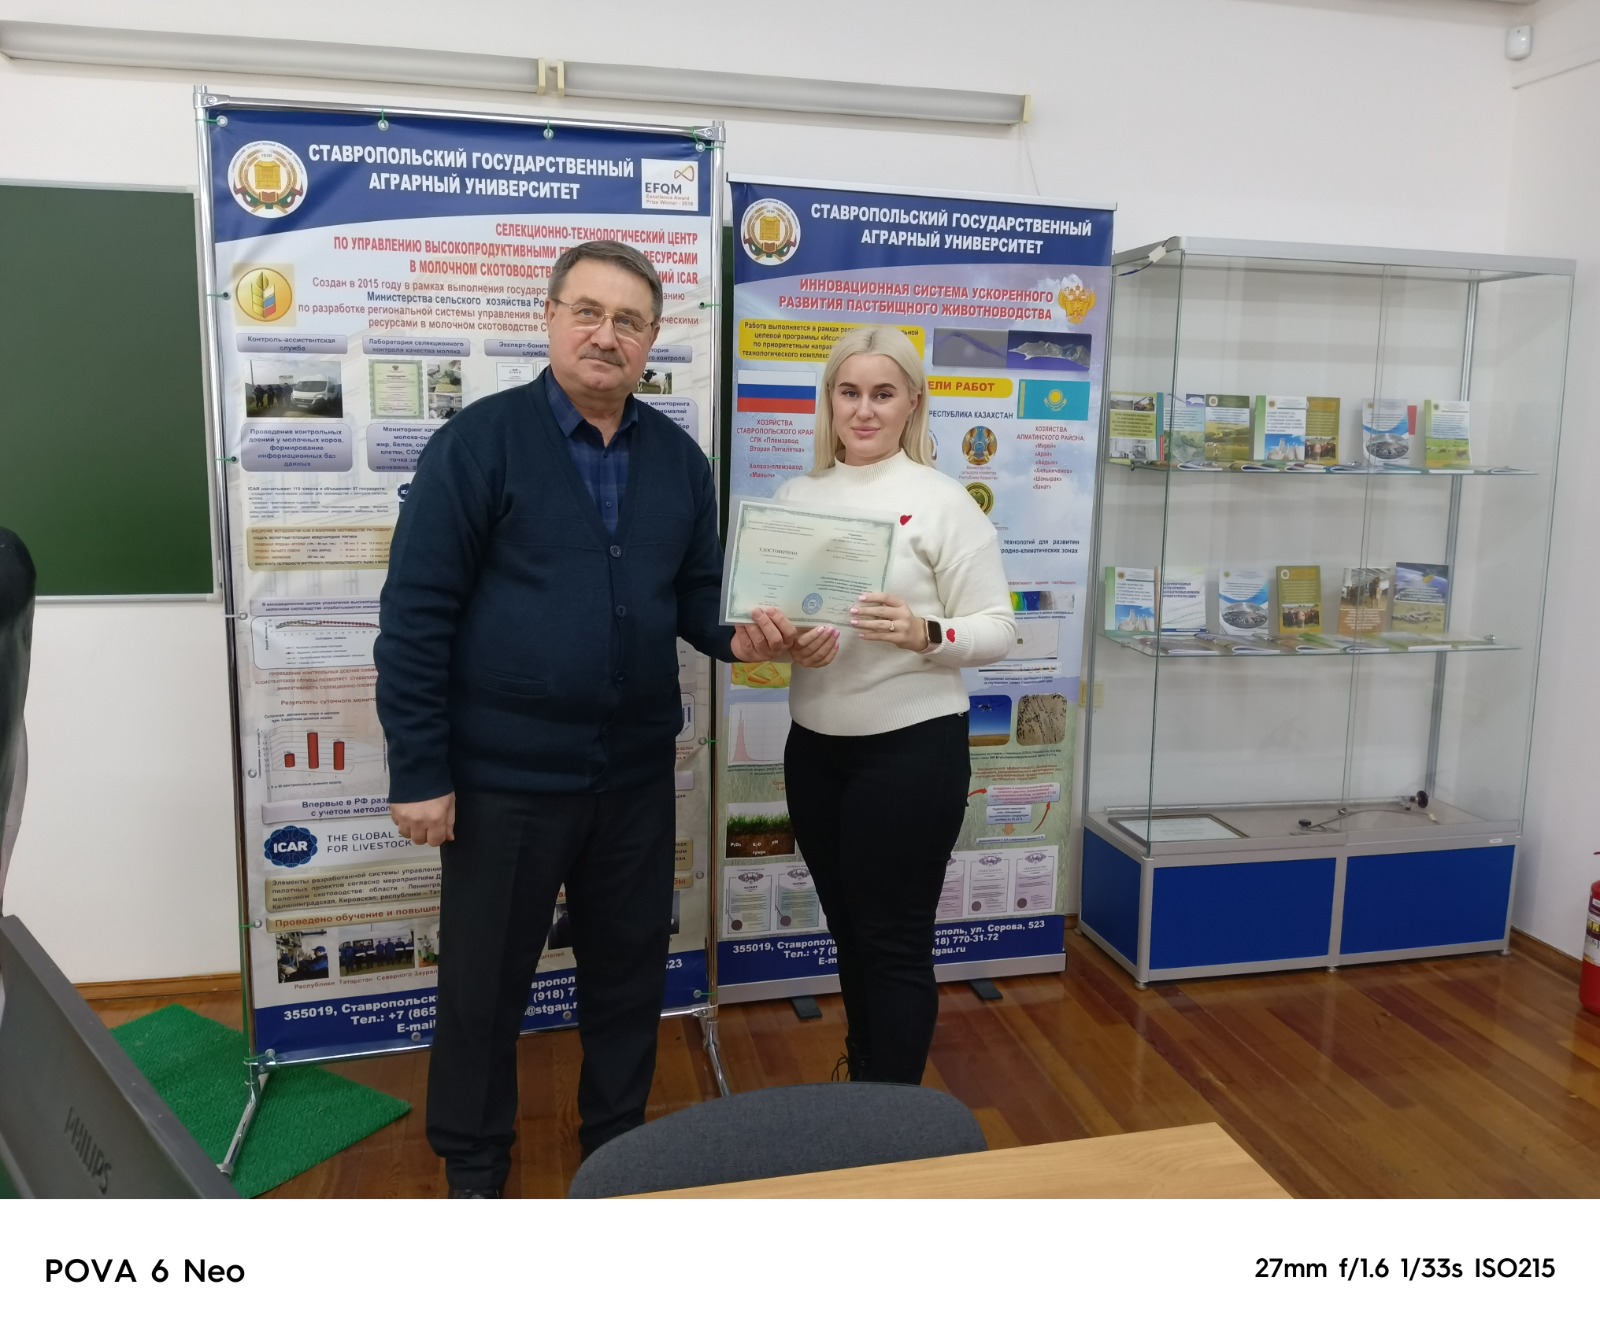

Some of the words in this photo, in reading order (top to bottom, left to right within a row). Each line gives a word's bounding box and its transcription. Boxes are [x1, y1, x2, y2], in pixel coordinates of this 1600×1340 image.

[308, 144, 467, 168] СТАВРОПОЛЬСКИЙ
[472, 152, 634, 178] ГОСУДАРСТВЕННЫЙ
[369, 172, 461, 194] АГРАРНЫЙ
[465, 178, 580, 200] УНИВЕРСИТЕТ
[645, 182, 682, 195] EFQM
[811, 203, 949, 227] СТАВРОПОЛЬСКИЙ
[952, 212, 1092, 237] ГОСУДАРСТВЕННЫЙ
[495, 222, 665, 244] СЕЛЕКЦИОННО-ТЕХНОЛОГИЧЕСКИЙ
[668, 232, 698, 246] ЦЕНТР
[333, 236, 348, 249] ПО
[351, 237, 422, 253] УПРАВЛЕНИЮ
[425, 241, 557, 259] ВЫСОКОПРОДУКТИВНЫМИ
[861, 229, 940, 248] АГРАРНЫЙ
[944, 234, 1044, 254] УНИВЕРСИТЕТ
[409, 259, 416, 272] В
[419, 260, 477, 275] МОЛОЧНОМ
[480, 262, 554, 279] СКОТОВОДСТВ
[677, 271, 698, 285] ICAR
[312, 277, 347, 290] Создан
[357, 278, 379, 289] 2015
[381, 281, 402, 292] году
[413, 283, 445, 294] рамках
[448, 284, 504, 295] выполнения
[800, 278, 911, 297] ИННОВАЦИОННАЯ
[913, 284, 970, 299] СИСТЕМА
[972, 287, 1054, 304] УСКОРЕННОГО
[367, 291, 433, 304] Министерства
[435, 295, 481, 306] сельского
[486, 296, 532, 307] хозяйства
[298, 303, 309, 313] по
[312, 303, 365, 316] разработке
[367, 305, 431, 317] региональной
[435, 309, 475, 318] системы
[477, 310, 531, 321] управления
[779, 295, 843, 311] РАЗВИТИЯ
[847, 297, 939, 316] ПАСТБИЩНОГО
[941, 305, 1053, 322] ЖИВОТНОВОДСТВА
[368, 318, 418, 330] ресурсами
[428, 320, 477, 329] молочном
[478, 322, 538, 333] скотоводстве
[744, 321, 767, 330] Работа
[768, 323, 810, 332] выполняется
[247, 335, 336, 344] Контроль-ассистентская
[368, 338, 413, 347] Лаборатория
[754, 332, 781, 341] целевой
[783, 334, 820, 343] программы
[279, 344, 306, 352] служба
[763, 341, 810, 350] приоритетным
[742, 350, 798, 359] технологического
[955, 381, 996, 392] РАБОТ
[929, 410, 973, 419] РЕСПУБЛИКА
[974, 411, 1014, 420] КАЗАХСТАН
[756, 418, 793, 427] ХОЗЯЙСТВА
[1035, 425, 1068, 433] ХОЗЯЙСТВА
[382, 426, 423, 434] Мониторинг
[736, 427, 796, 436] СТАВРОПОЛЬСКОГО
[797, 428, 814, 436] КРАЯ
[749, 436, 762, 444] СПК
[749, 445, 770, 453] Вторая
[258, 452, 323, 461] информационных
[1052, 538, 1080, 546] развития
[281, 698, 318, 707] Результаты
[319, 697, 352, 705] суточного
[302, 800, 343, 810] Впервые
[354, 797, 368, 806] РФ
[318, 808, 351, 818] учетом
[327, 834, 349, 843] THE
[351, 832, 394, 842] GLOBAL
[273, 840, 308, 855] ICAR
[327, 845, 350, 854] FOR
[352, 839, 413, 852] LIVESTOCK
[272, 878, 310, 888] Элементы
[311, 873, 366, 885] разработанной
[368, 869, 400, 877] системы
[272, 886, 308, 895] пилотных
[311, 882, 345, 892] проектов
[347, 879, 381, 889] согласно
[272, 893, 310, 903] молочном
[369, 885, 399, 895] области
[380, 891, 422, 903] республики
[275, 915, 333, 928] Проведено
[336, 910, 385, 924] обучение
[970, 925, 985, 937] ул.
[987, 922, 1026, 935] Серова,
[1028, 919, 1045, 930] 523
[953, 932, 999, 945] 770-31-72
[732, 940, 774, 954] 355019,
[783, 948, 810, 960] Тел.:
[811, 946, 825, 957] +7
[293, 979, 335, 991] Республики
[376, 971, 413, 982] Северного
[533, 987, 564, 1004] (918)
[283, 1004, 338, 1021] 355019,
[350, 1014, 384, 1026] Тел.:
[389, 1010, 404, 1020] +7
